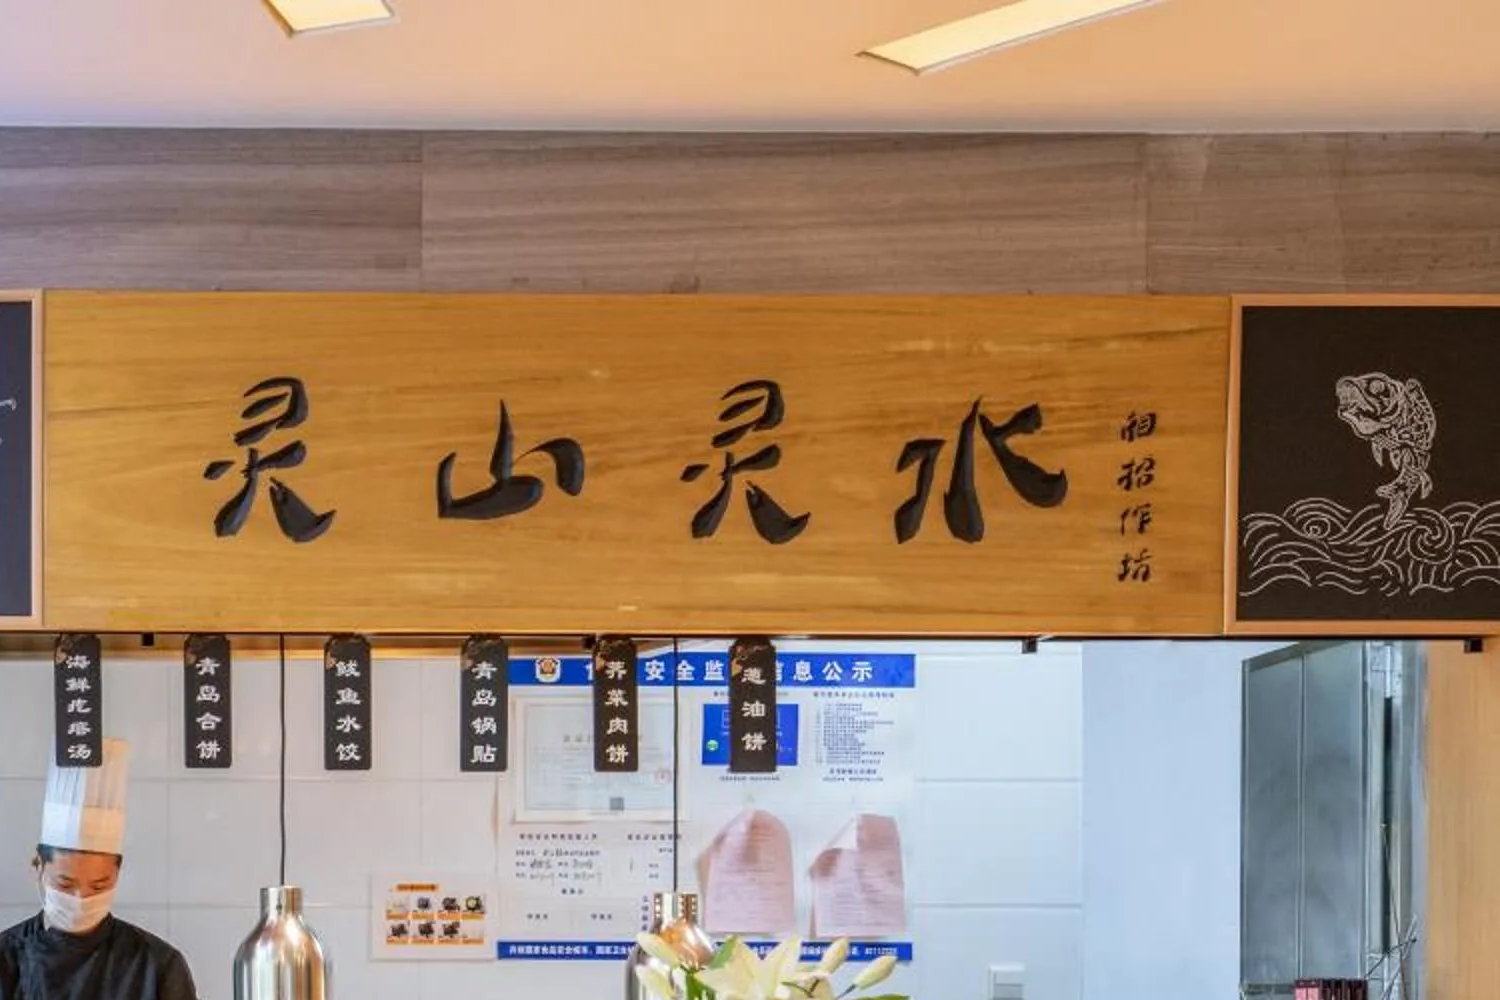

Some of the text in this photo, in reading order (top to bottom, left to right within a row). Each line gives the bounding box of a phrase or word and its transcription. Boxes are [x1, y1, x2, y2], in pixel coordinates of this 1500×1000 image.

[203, 376, 1069, 545] 灵山灵水
[195, 657, 222, 760] 青岛合饼
[335, 659, 361, 762] 鲅鱼水饺
[469, 660, 498, 764] 青岛锅贴
